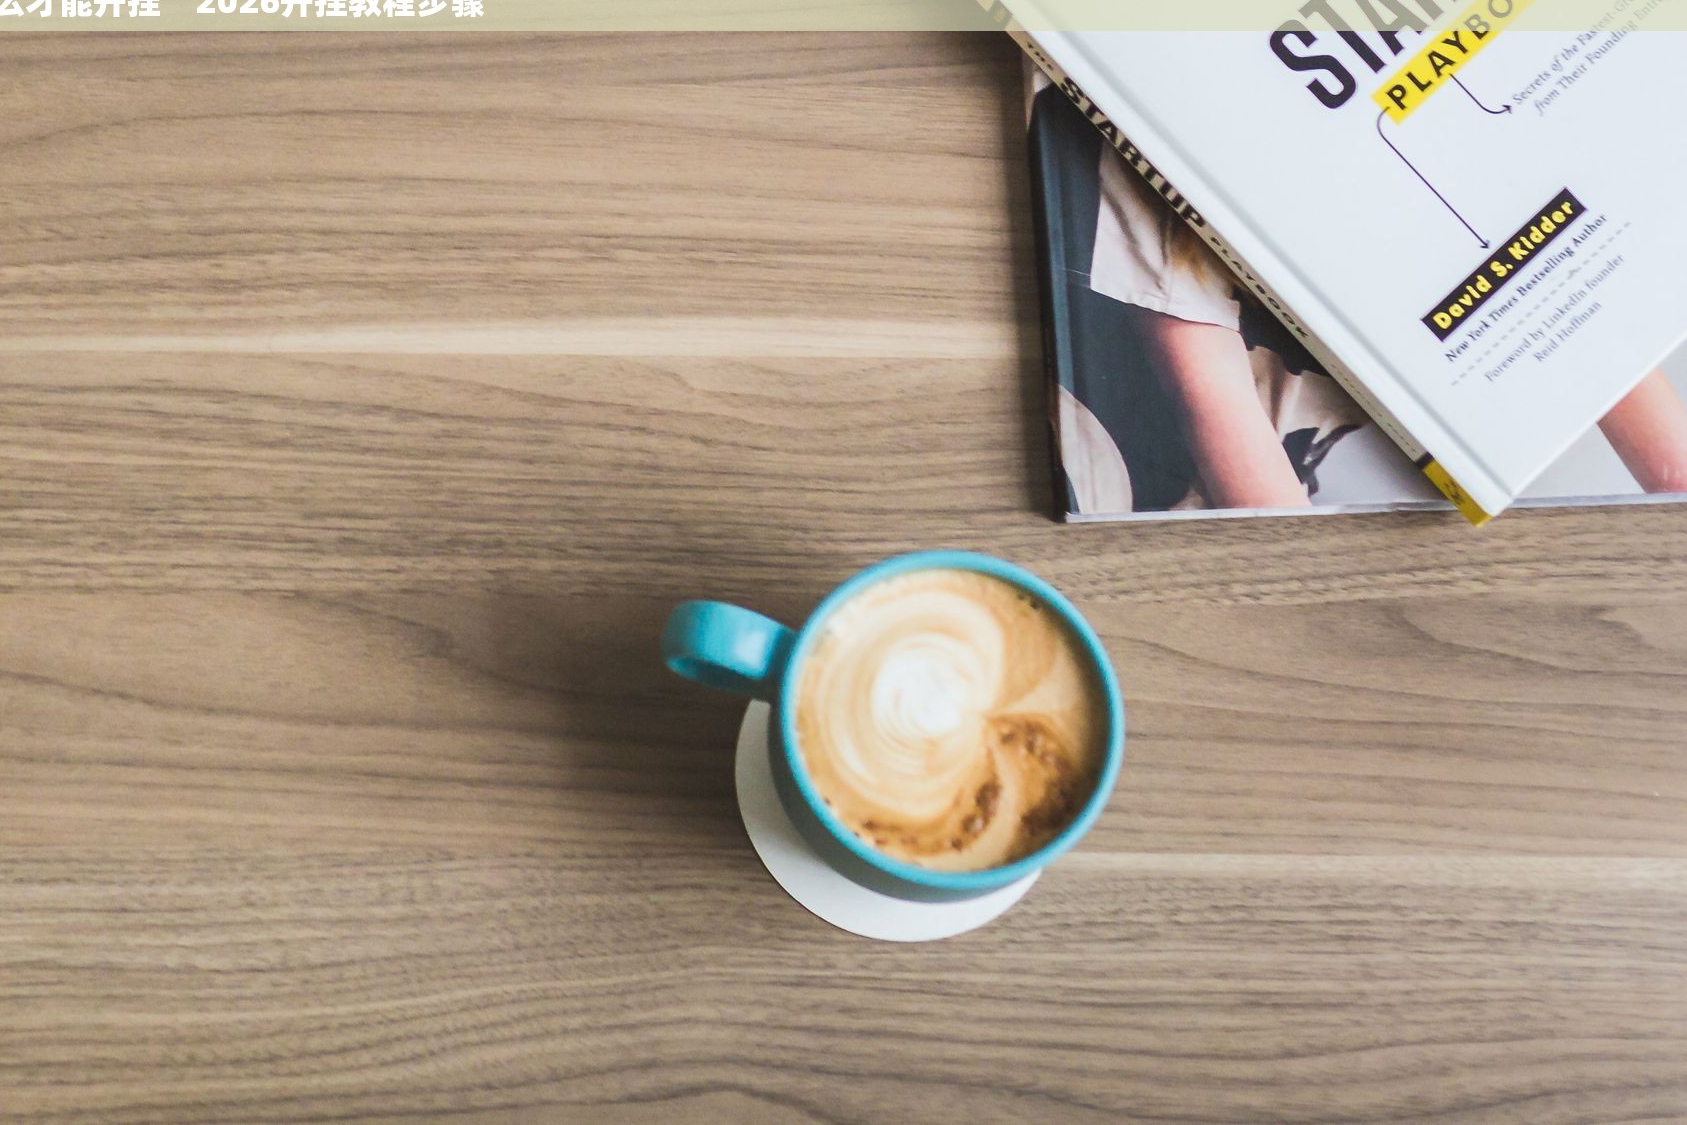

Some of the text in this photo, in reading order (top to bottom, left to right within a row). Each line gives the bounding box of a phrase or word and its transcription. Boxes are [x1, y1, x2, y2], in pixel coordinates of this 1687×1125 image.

[1513, 70, 1551, 105] Secrets
[1556, 63, 1587, 91] Their
[1584, 22, 1637, 65] Founding
[1059, 76, 1309, 339] STARTUP PLAYBOOK
[1432, 201, 1572, 329] David S. Kidder
[1444, 215, 1606, 361] New York Times Bestselling Author
